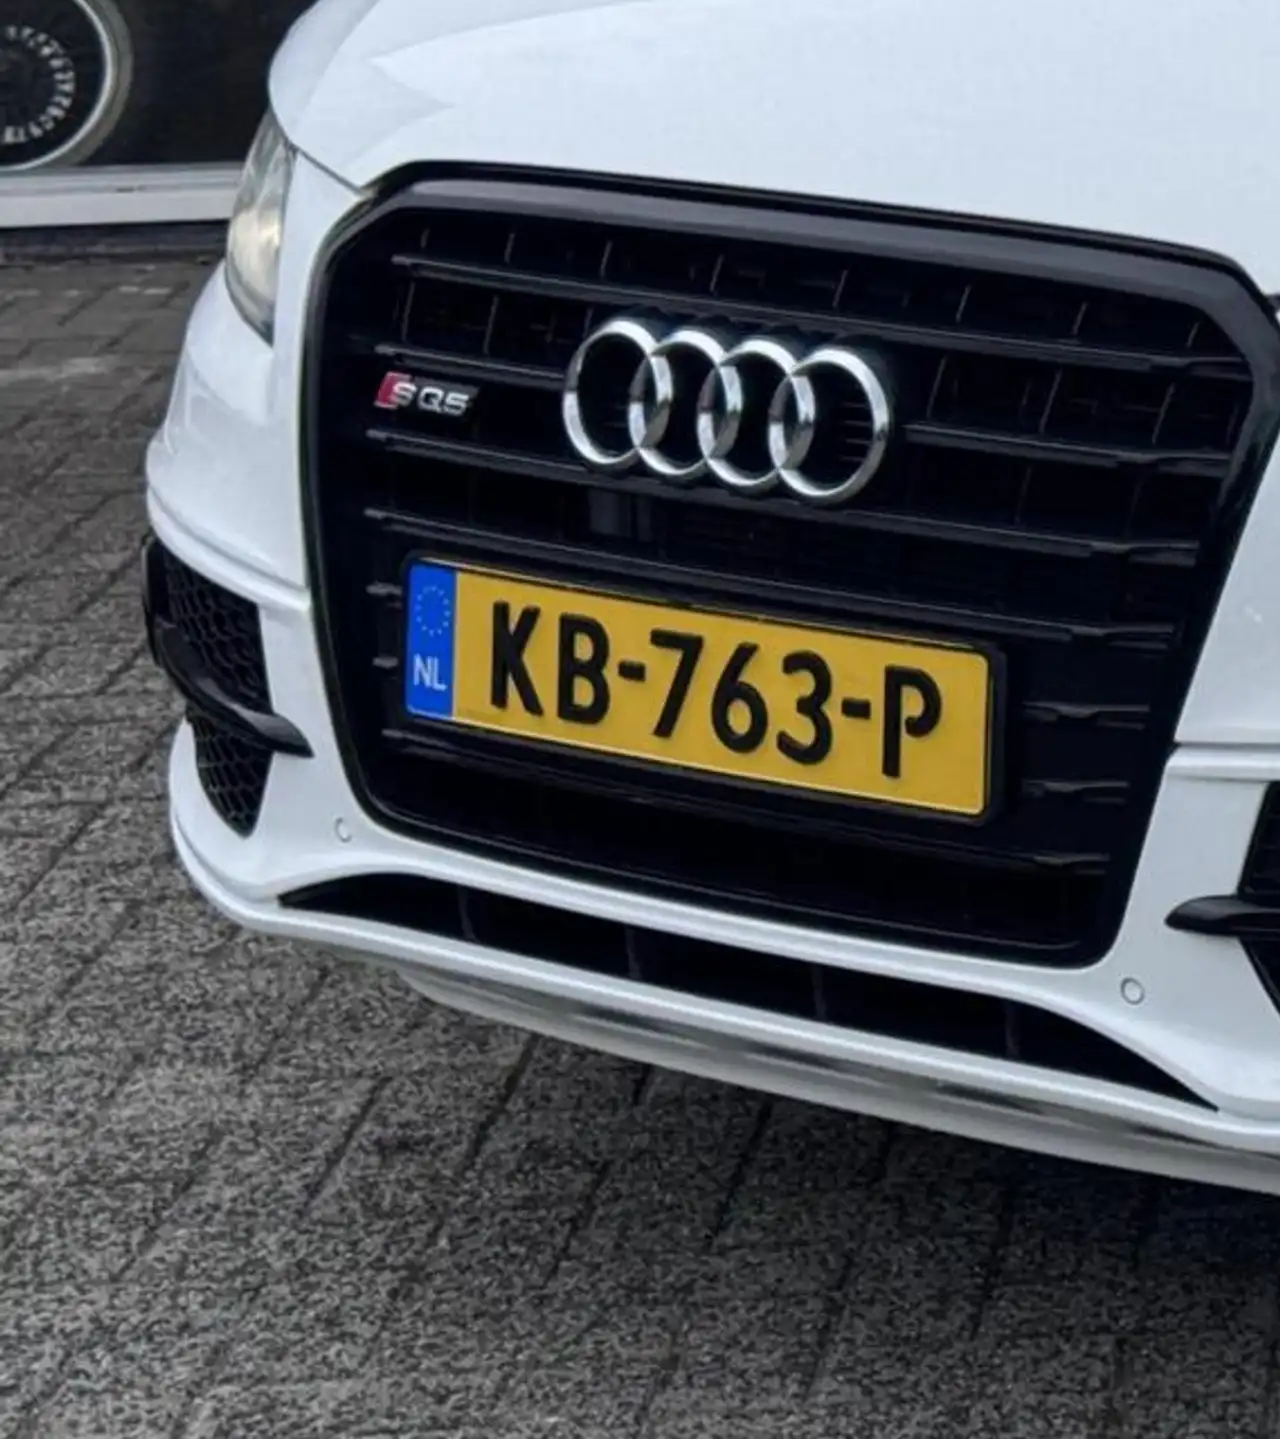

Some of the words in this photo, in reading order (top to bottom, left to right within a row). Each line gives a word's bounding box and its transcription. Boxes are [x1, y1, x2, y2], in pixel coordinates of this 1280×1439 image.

[375, 371, 470, 417] SQ5
[412, 656, 449, 692] NL
[489, 600, 943, 778] KB-763-P
